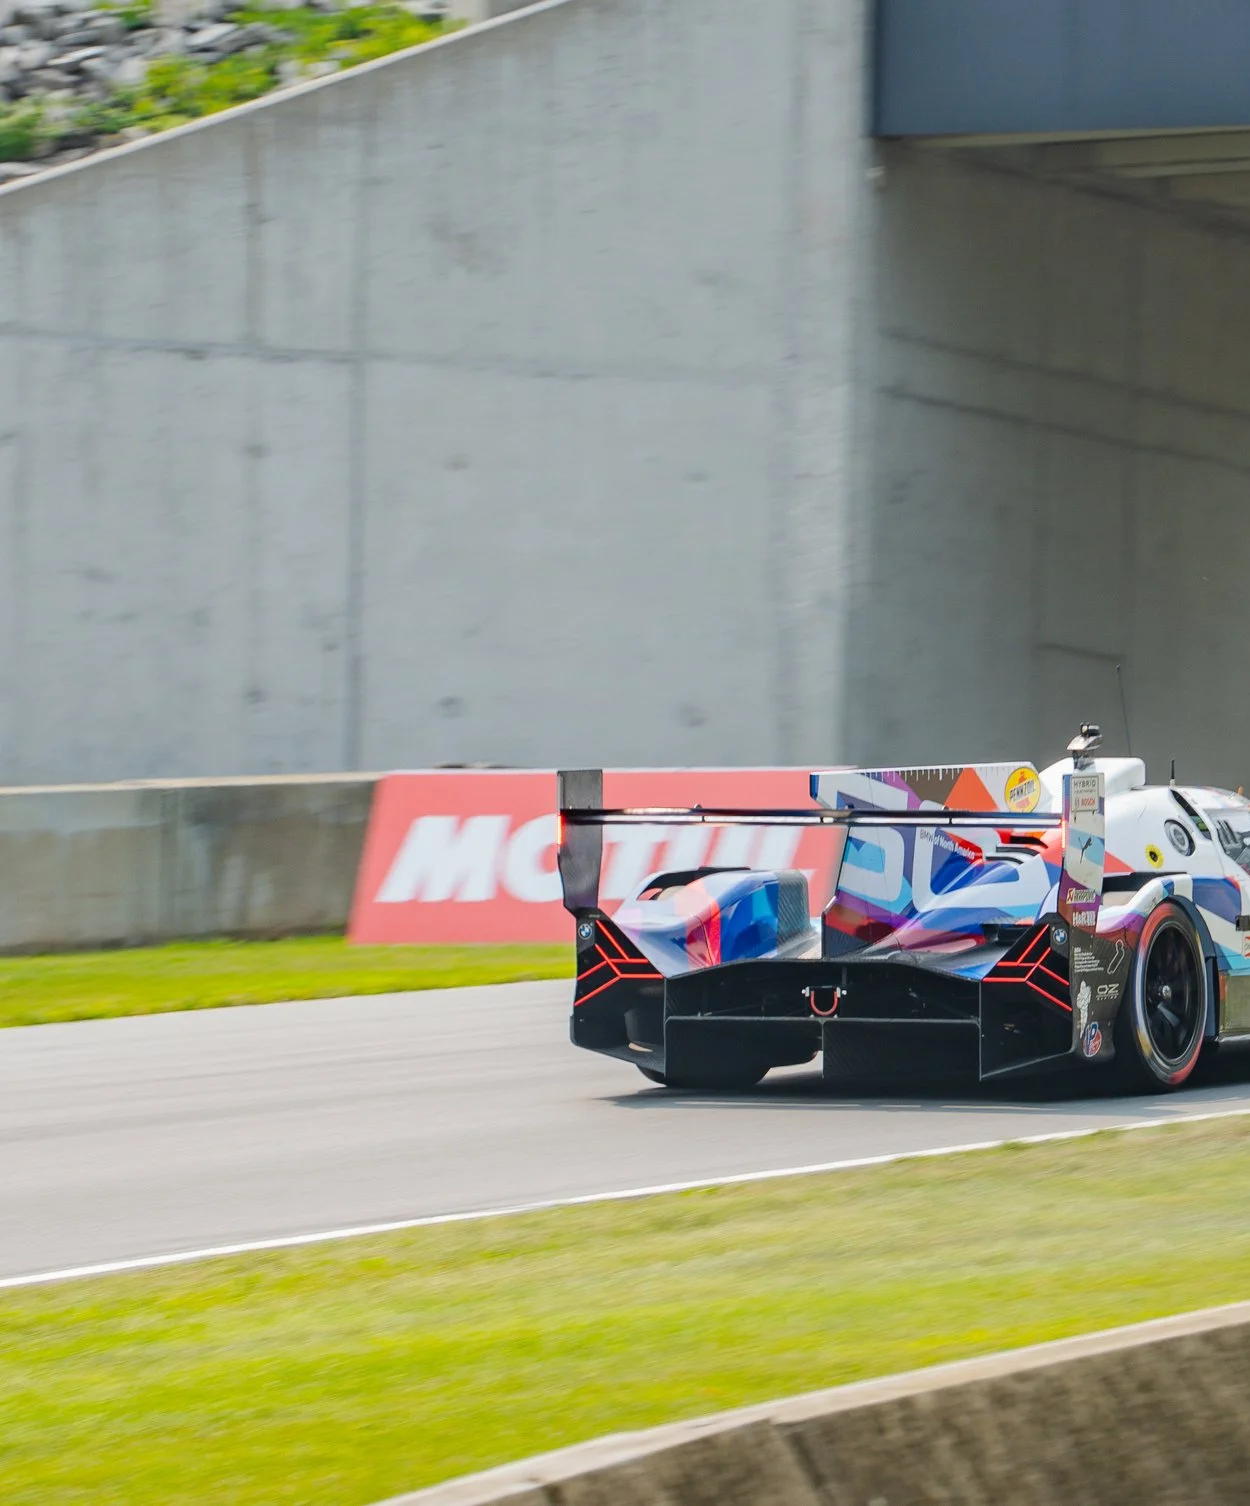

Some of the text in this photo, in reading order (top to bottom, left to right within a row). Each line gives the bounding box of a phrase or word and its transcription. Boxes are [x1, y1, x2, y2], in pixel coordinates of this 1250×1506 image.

[1073, 780, 1096, 789] HYBRID
[940, 836, 954, 852] North
[1097, 984, 1119, 995] OZ
